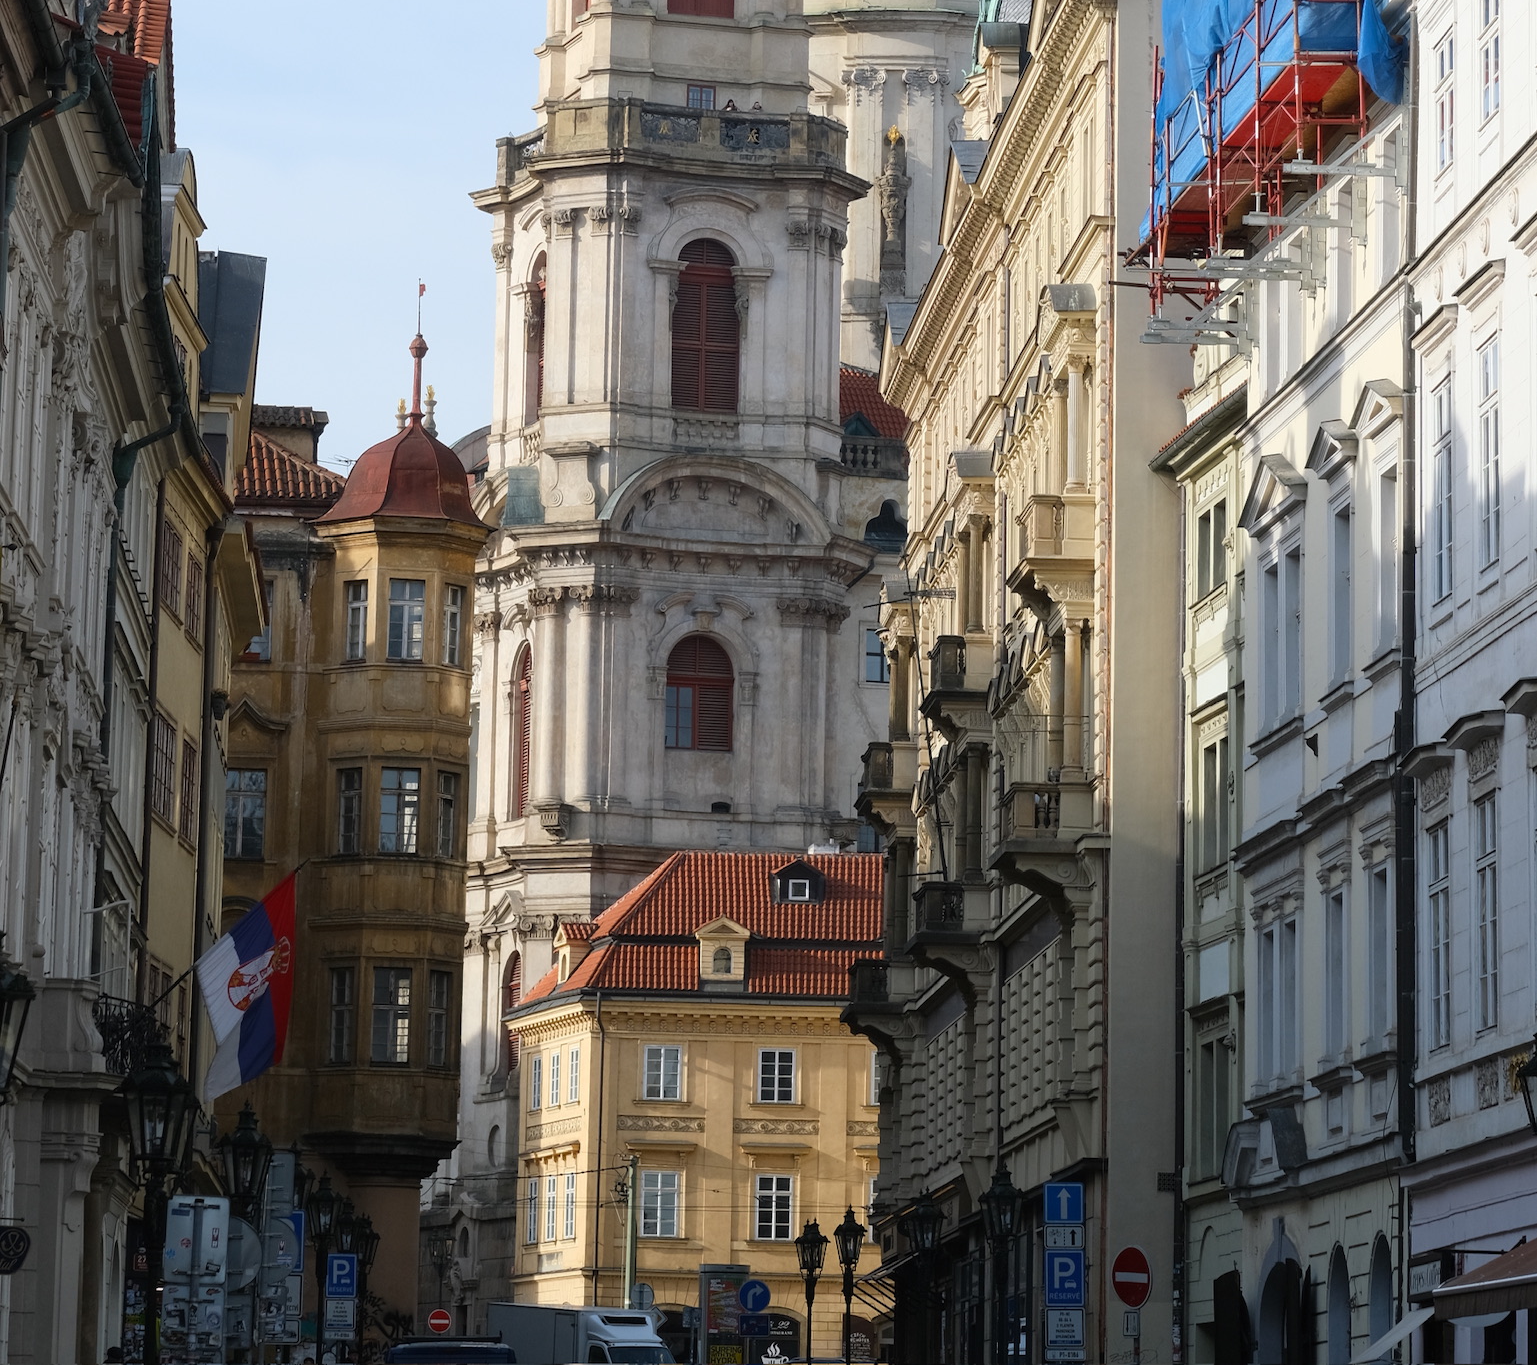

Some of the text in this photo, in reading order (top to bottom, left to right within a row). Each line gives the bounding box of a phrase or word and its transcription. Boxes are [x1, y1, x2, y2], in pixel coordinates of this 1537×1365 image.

[138, 1255, 147, 1263] 27
[333, 1259, 350, 1284] P
[1054, 1257, 1075, 1289] P
[1049, 1291, 1080, 1300] RÉSERVÉ
[710, 1345, 742, 1354] SURFING
